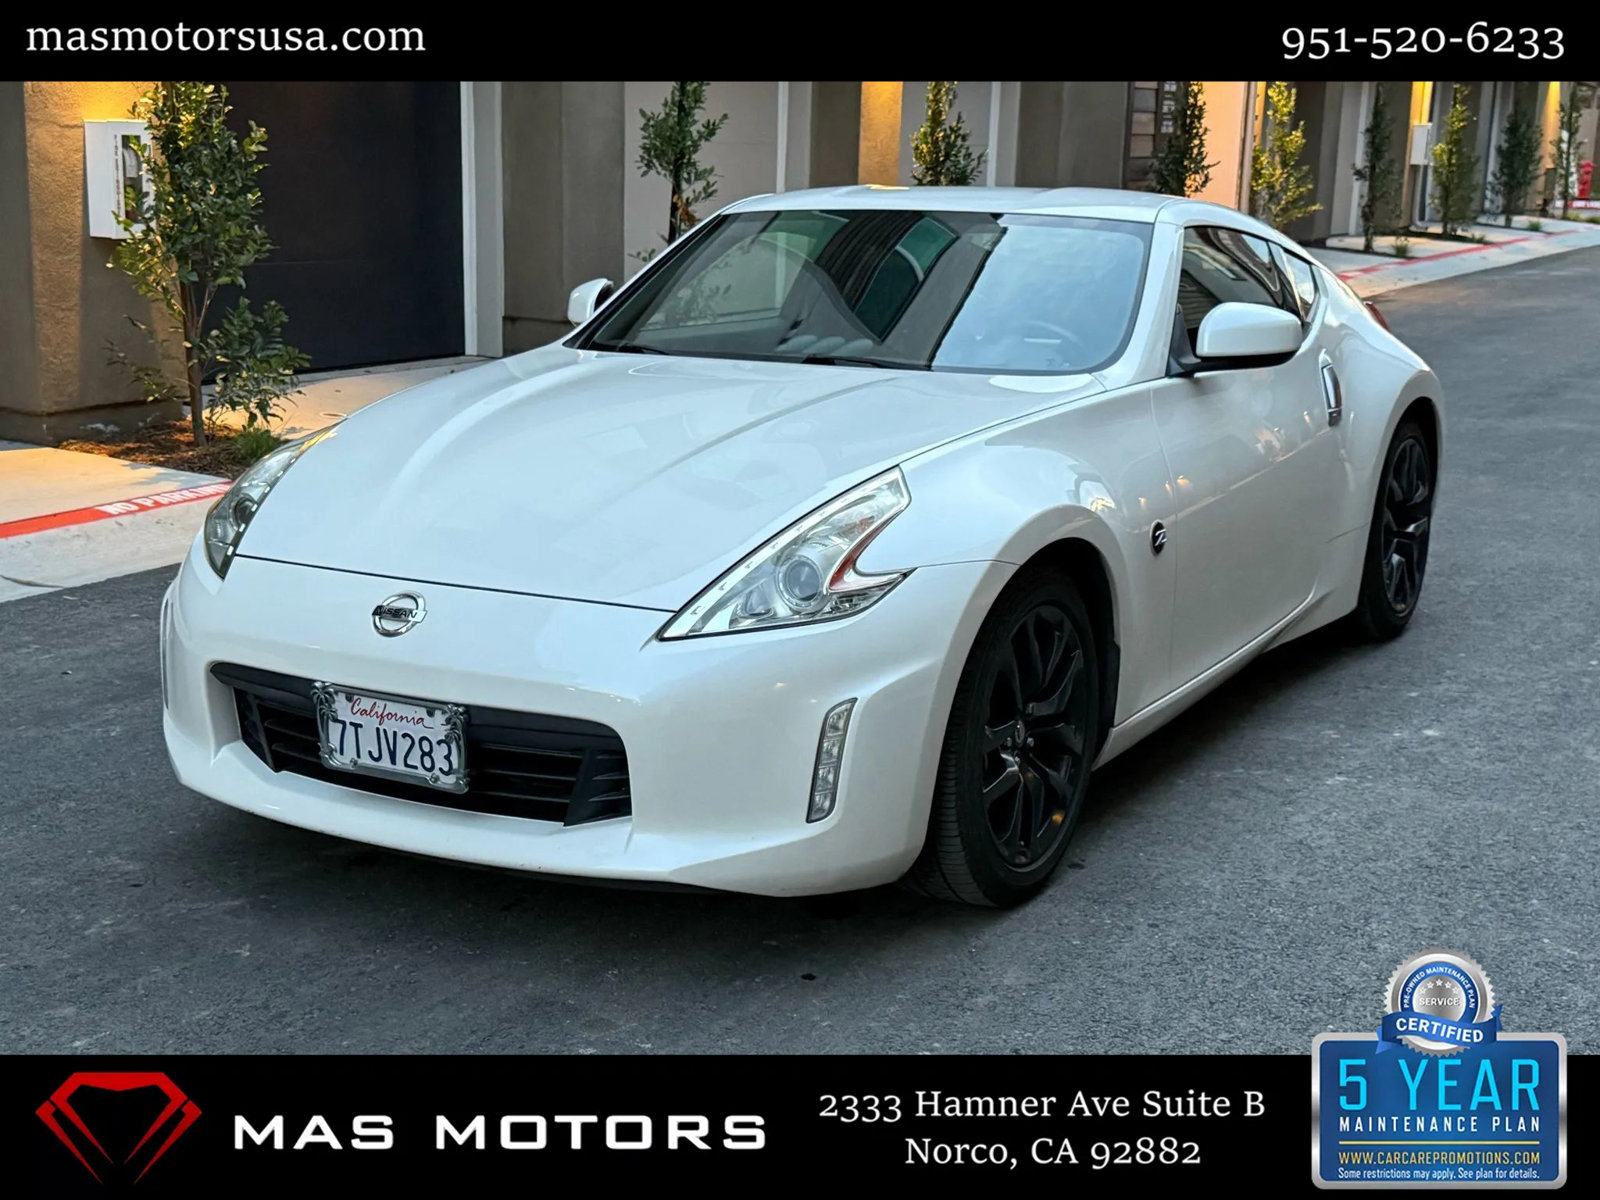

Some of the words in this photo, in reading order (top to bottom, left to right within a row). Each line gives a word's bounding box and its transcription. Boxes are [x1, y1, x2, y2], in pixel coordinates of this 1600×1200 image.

[373, 605, 419, 620] NISSAN
[350, 697, 435, 729] California
[330, 718, 454, 777] 7TJV283
